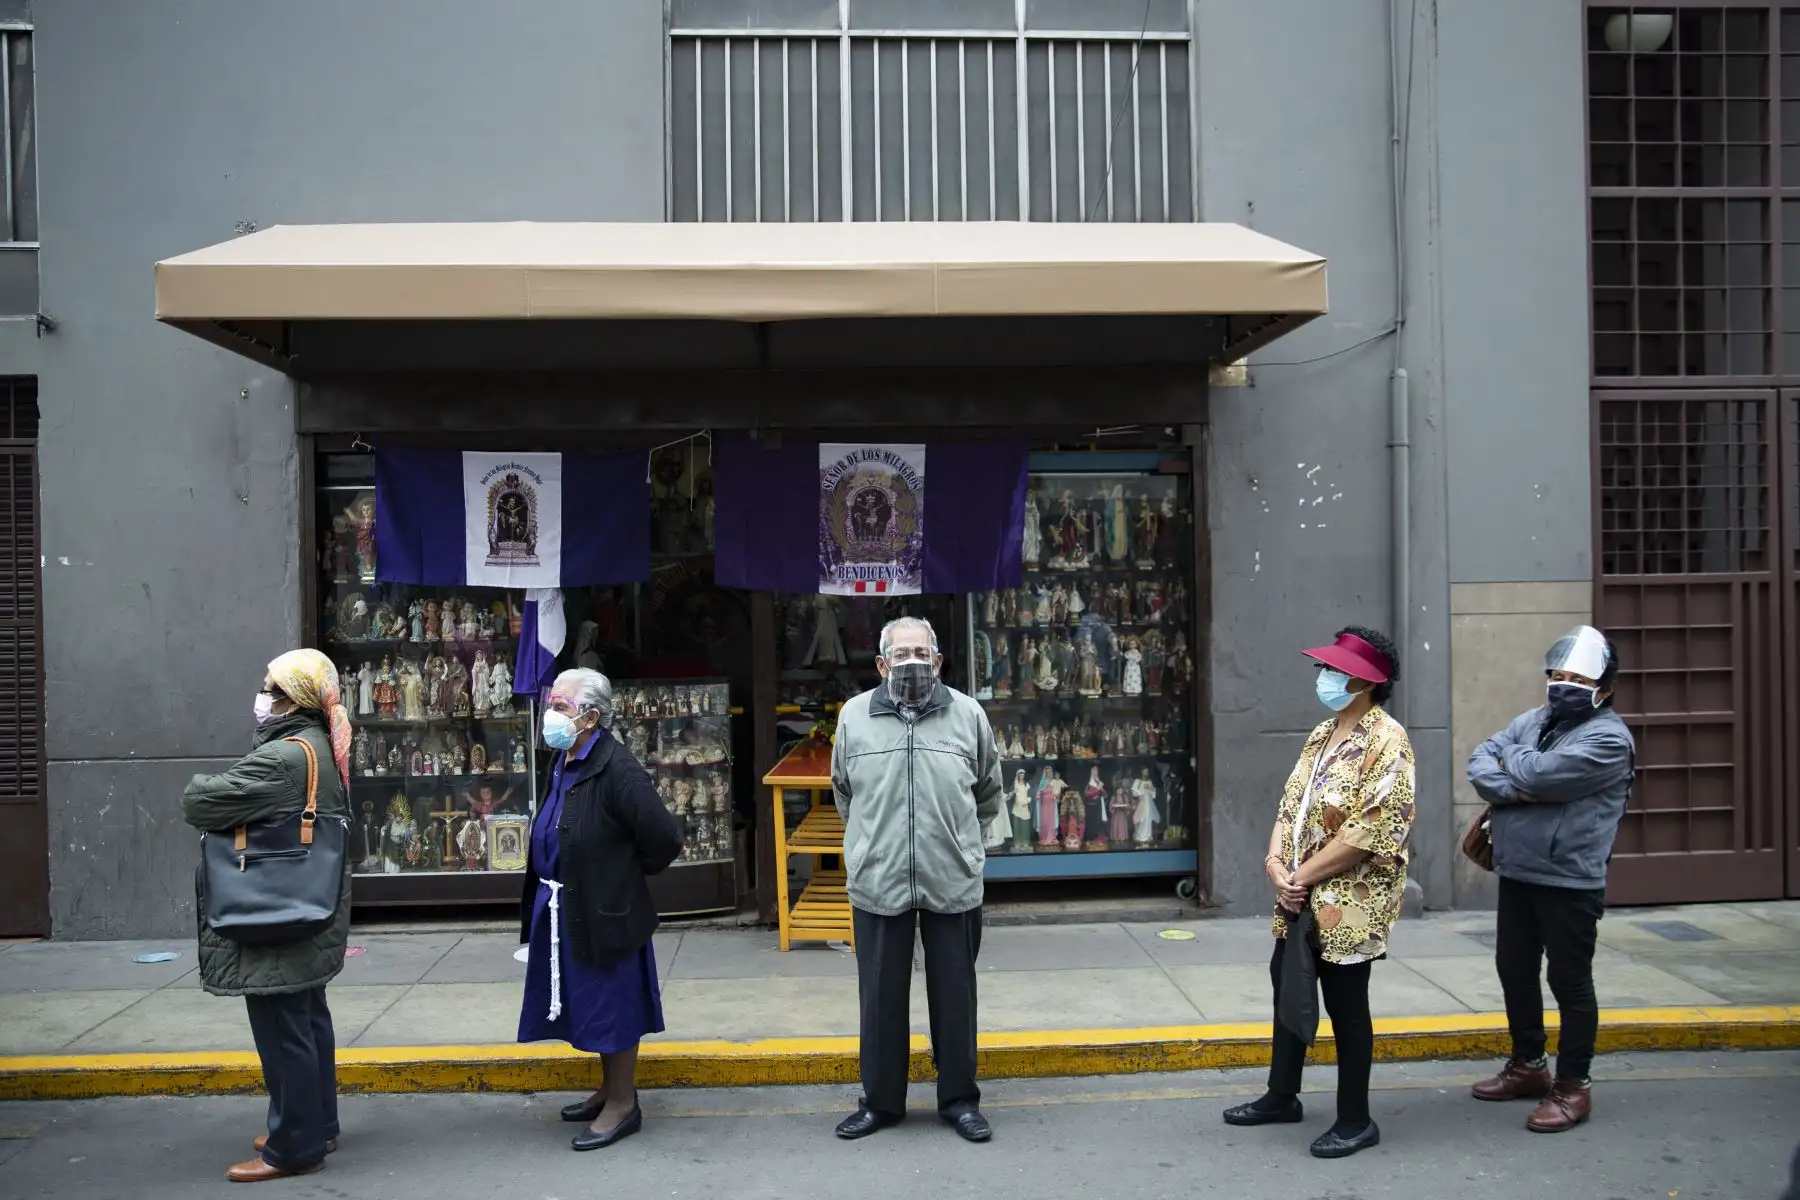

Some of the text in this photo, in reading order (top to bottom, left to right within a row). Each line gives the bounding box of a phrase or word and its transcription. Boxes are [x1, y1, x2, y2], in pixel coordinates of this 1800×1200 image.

[823, 449, 922, 491] SEÑOR DE LOS MILAGROS
[838, 564, 905, 579] BENDICENOS
